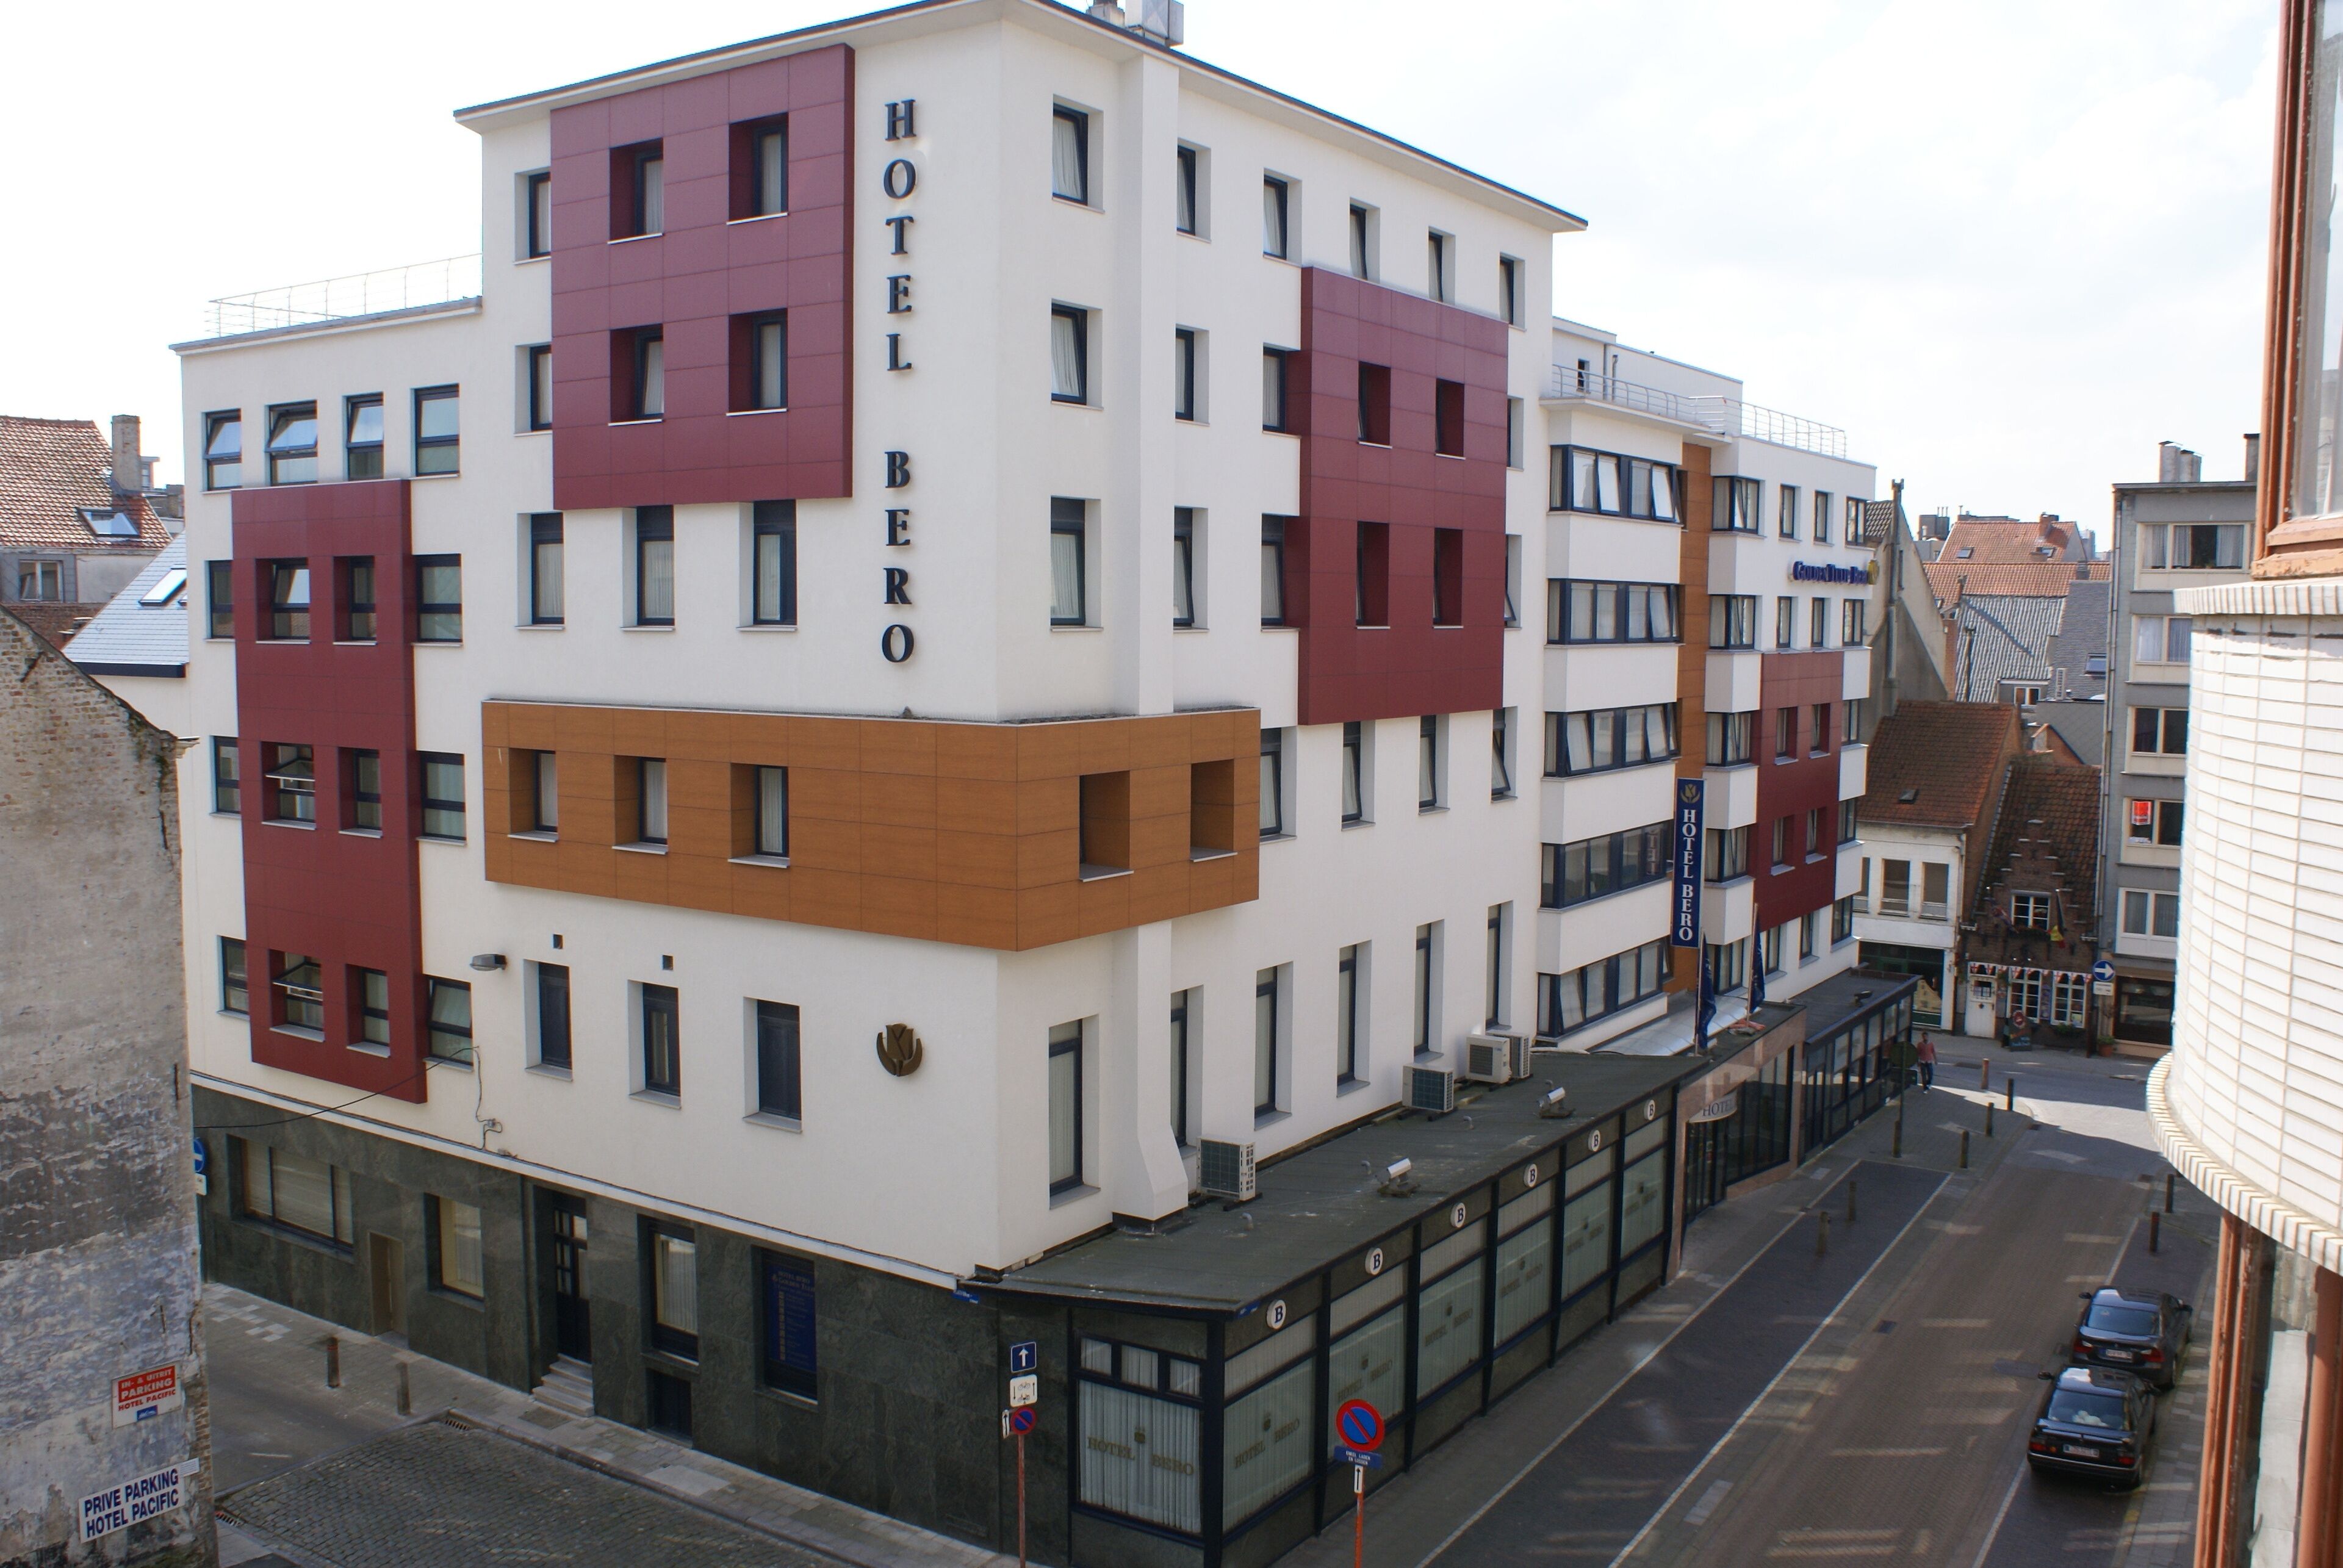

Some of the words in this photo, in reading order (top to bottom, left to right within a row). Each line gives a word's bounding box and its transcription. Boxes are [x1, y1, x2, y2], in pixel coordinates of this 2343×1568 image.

[884, 99, 916, 371] HOTEL
[882, 451, 915, 663] BERO
[1682, 809, 1696, 879] HOTEL
[1679, 885, 1693, 941] BERO
[1530, 1169, 1536, 1182] B
[1458, 1208, 1464, 1223] B
[1373, 1254, 1380, 1270] B
[1275, 1306, 1283, 1323] B
[118, 1400, 143, 1411] HOTEL
[146, 1389, 176, 1403] PACIFIC
[121, 1378, 173, 1399] PARKING
[1087, 1436, 1135, 1461] HOTEL
[1152, 1454, 1194, 1475] BERO
[1235, 1440, 1265, 1469] HOTEL
[1275, 1417, 1299, 1443] BERO
[84, 1487, 121, 1517] PRIVE
[125, 1468, 178, 1502] PARKING
[87, 1508, 128, 1537] HOTEL
[132, 1489, 179, 1520] PACIFIC
